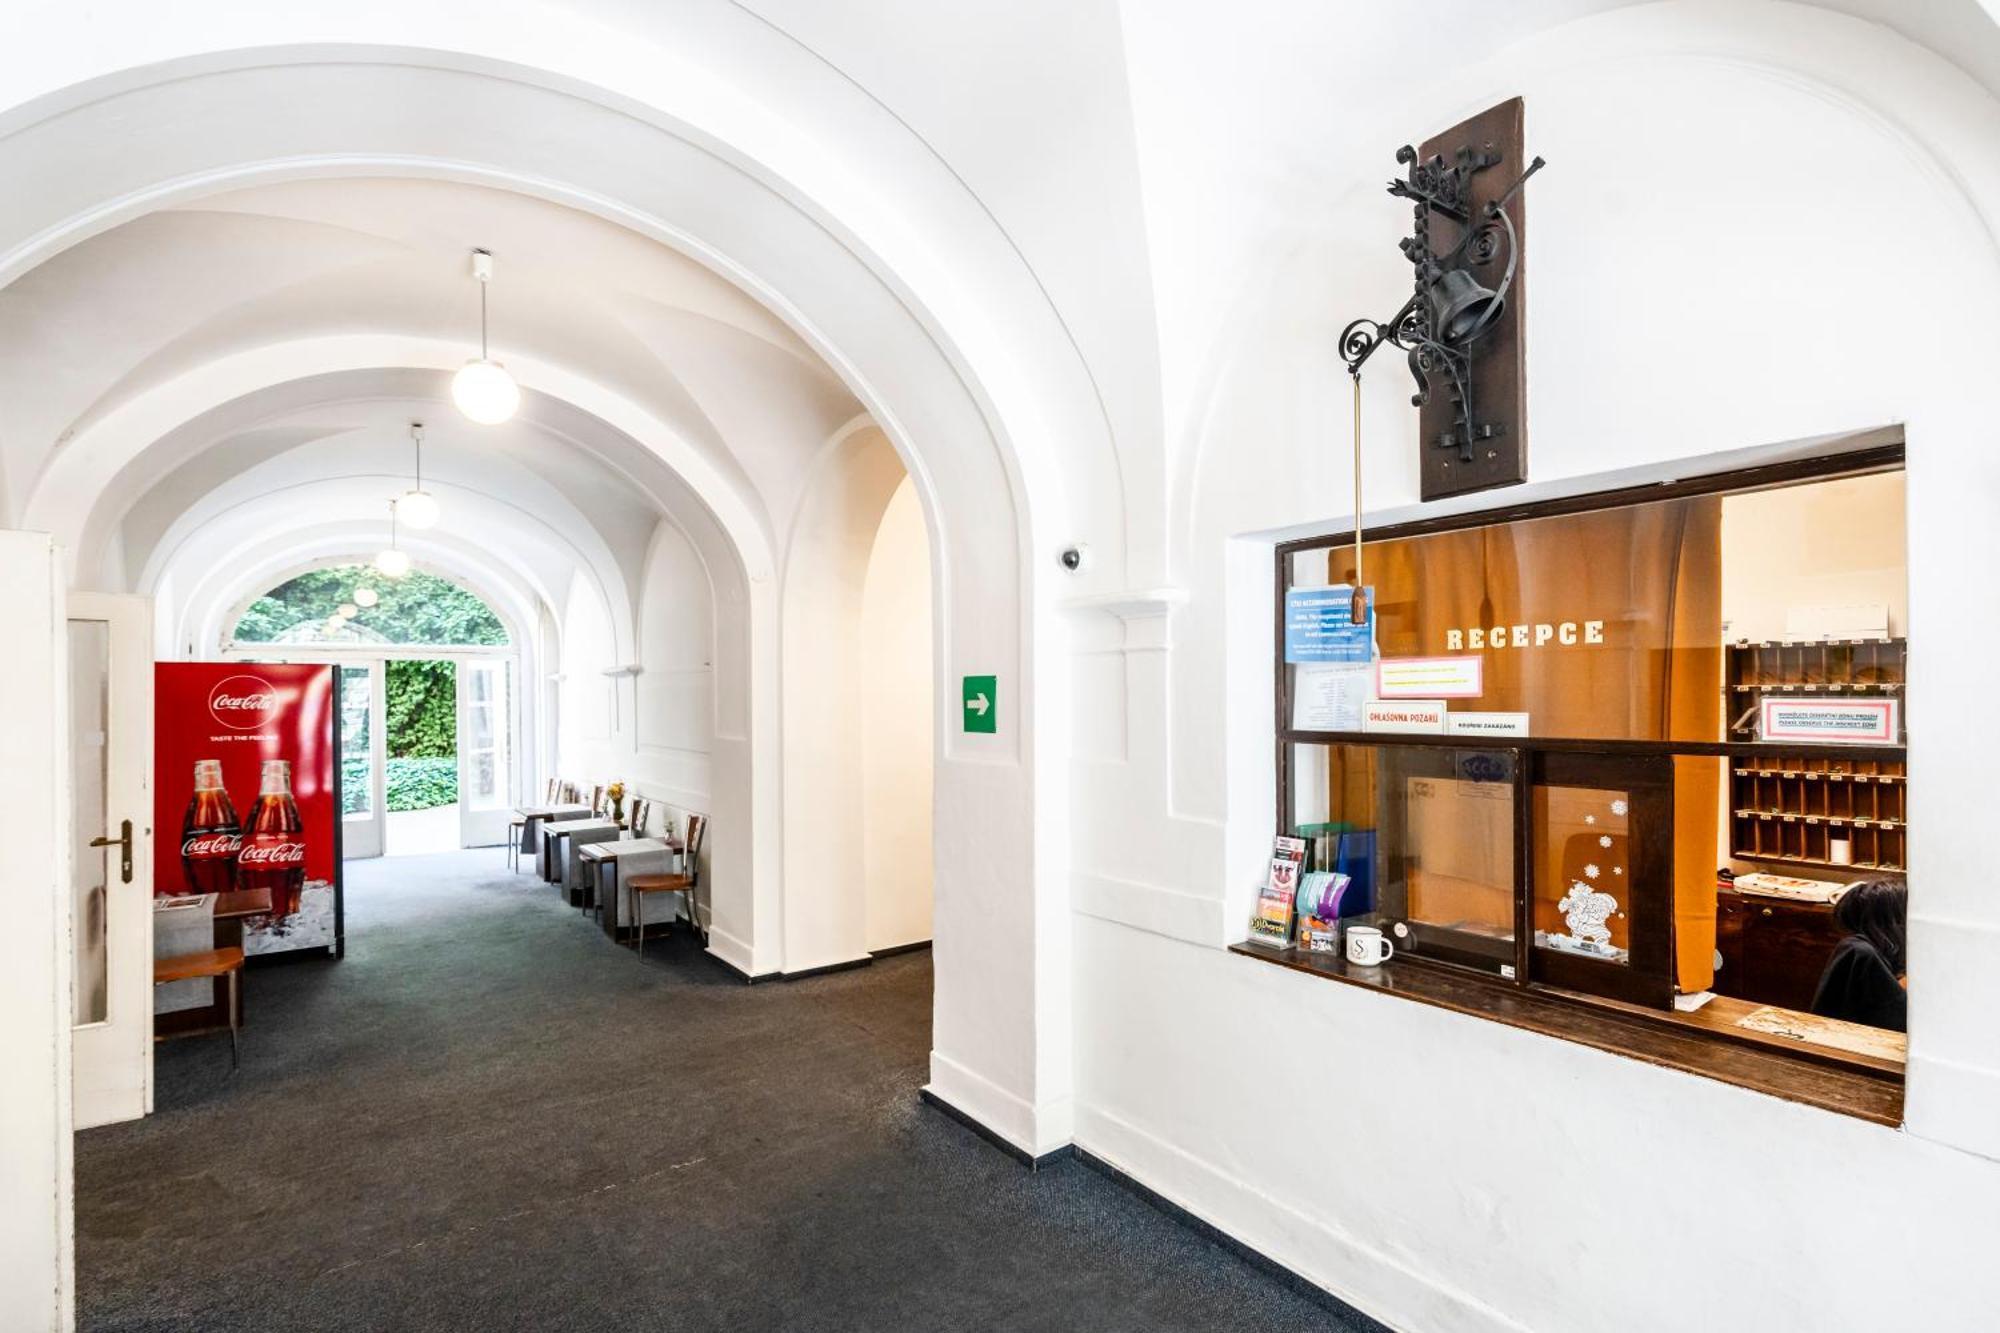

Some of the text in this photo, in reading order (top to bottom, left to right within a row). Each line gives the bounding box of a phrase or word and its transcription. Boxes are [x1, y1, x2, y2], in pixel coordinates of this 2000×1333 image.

[1447, 620, 1604, 650] RECEPCE
[213, 694, 273, 710] Coca-Cola
[181, 834, 245, 857] Coca-Cola
[238, 843, 306, 864] Coca-Cola
